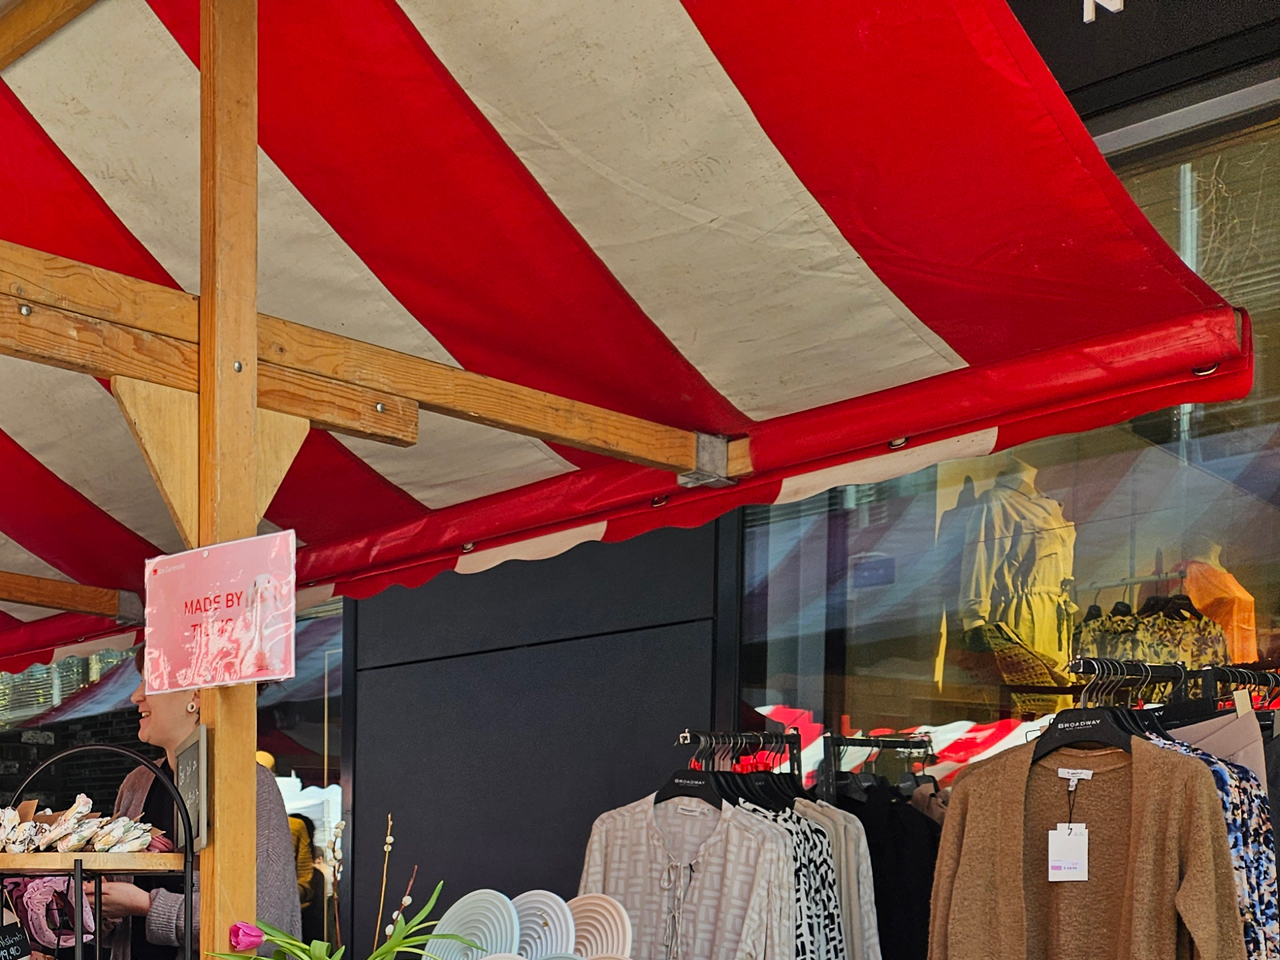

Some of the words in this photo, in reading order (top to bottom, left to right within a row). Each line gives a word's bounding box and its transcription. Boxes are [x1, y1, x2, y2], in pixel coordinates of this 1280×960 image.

[184, 594, 221, 615] MADE
[226, 591, 243, 608] BY
[1057, 719, 1101, 729] BROADWAY
